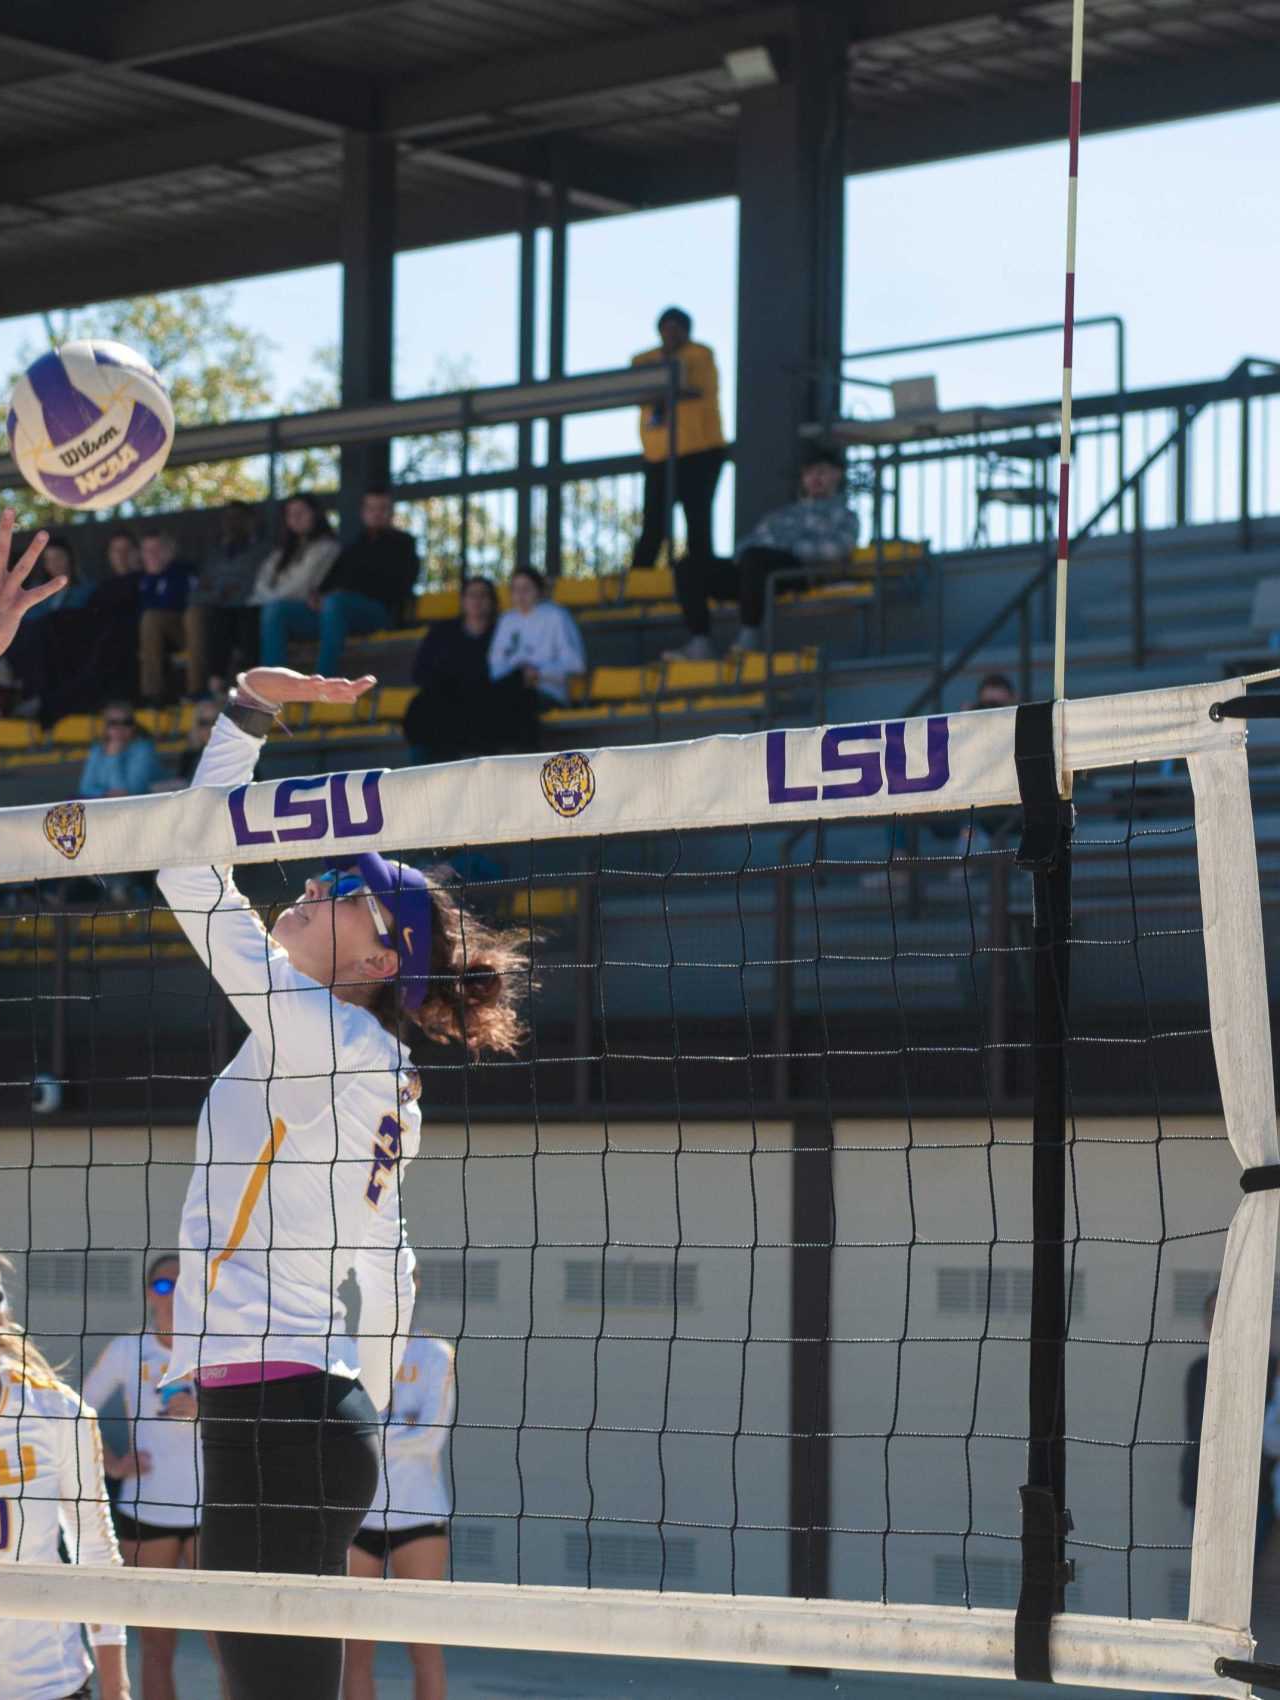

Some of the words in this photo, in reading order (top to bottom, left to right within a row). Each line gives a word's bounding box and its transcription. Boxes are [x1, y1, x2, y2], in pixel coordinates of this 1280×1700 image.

[59, 425, 119, 467] Wilson
[766, 716, 950, 804] LSU
[228, 771, 384, 846] LSU
